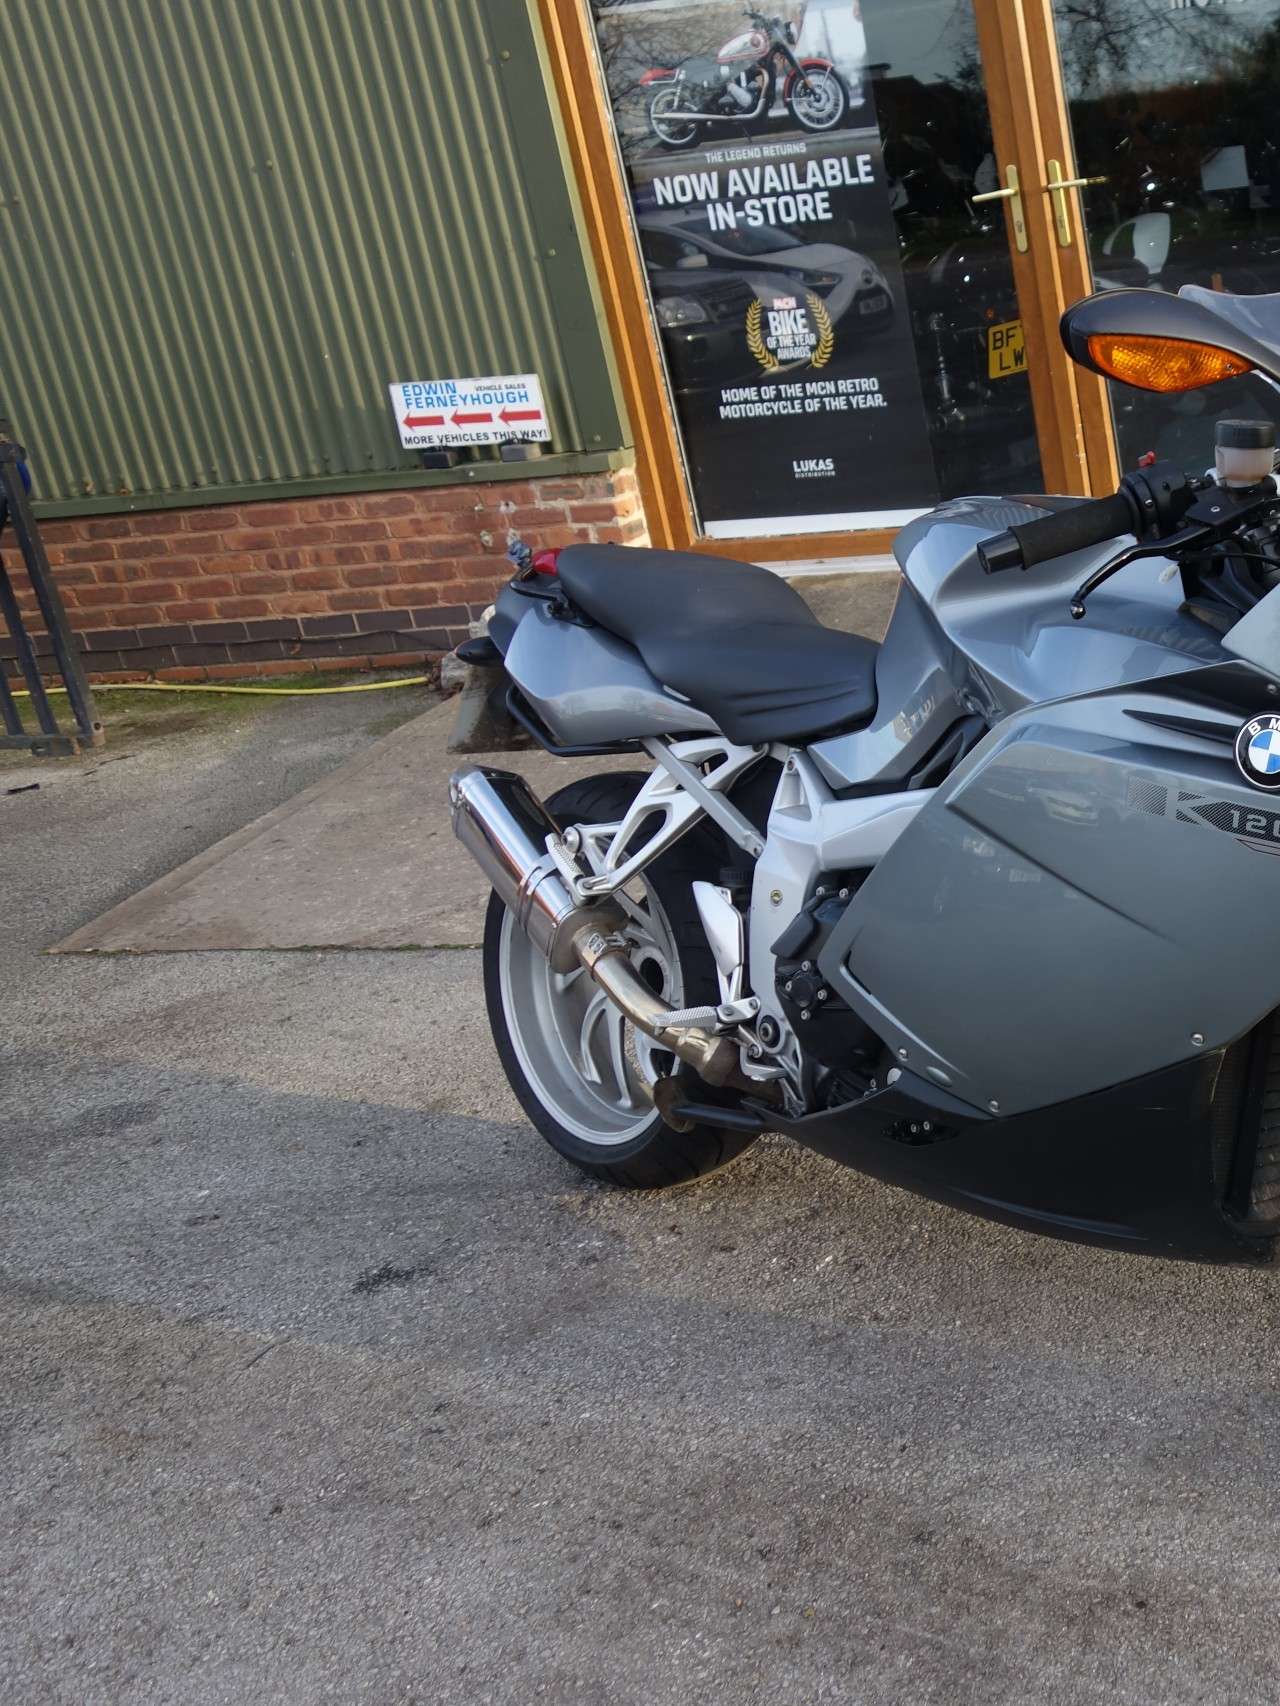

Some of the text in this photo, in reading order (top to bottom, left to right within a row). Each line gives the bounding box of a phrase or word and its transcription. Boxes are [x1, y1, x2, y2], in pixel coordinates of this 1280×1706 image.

[705, 143, 807, 164] THE LEGEND RETURNS
[653, 154, 875, 205] NOW AVAILABLE
[706, 191, 833, 231] IN-STORE
[767, 308, 809, 336] BIKE
[766, 333, 817, 349] OF THE YEAR
[777, 346, 812, 360] AWARDS
[402, 382, 457, 397] EDWIN
[475, 384, 501, 392] VEHICLE
[721, 377, 879, 403] HOME OF THE MCN RETRO
[405, 390, 529, 409] FERNEYHOUGH
[719, 393, 888, 420] MOTORCYCLE OF THE YEAR.
[404, 429, 548, 446] MORE VEHICLES THIS WAY!
[793, 458, 834, 472] LUKAS
